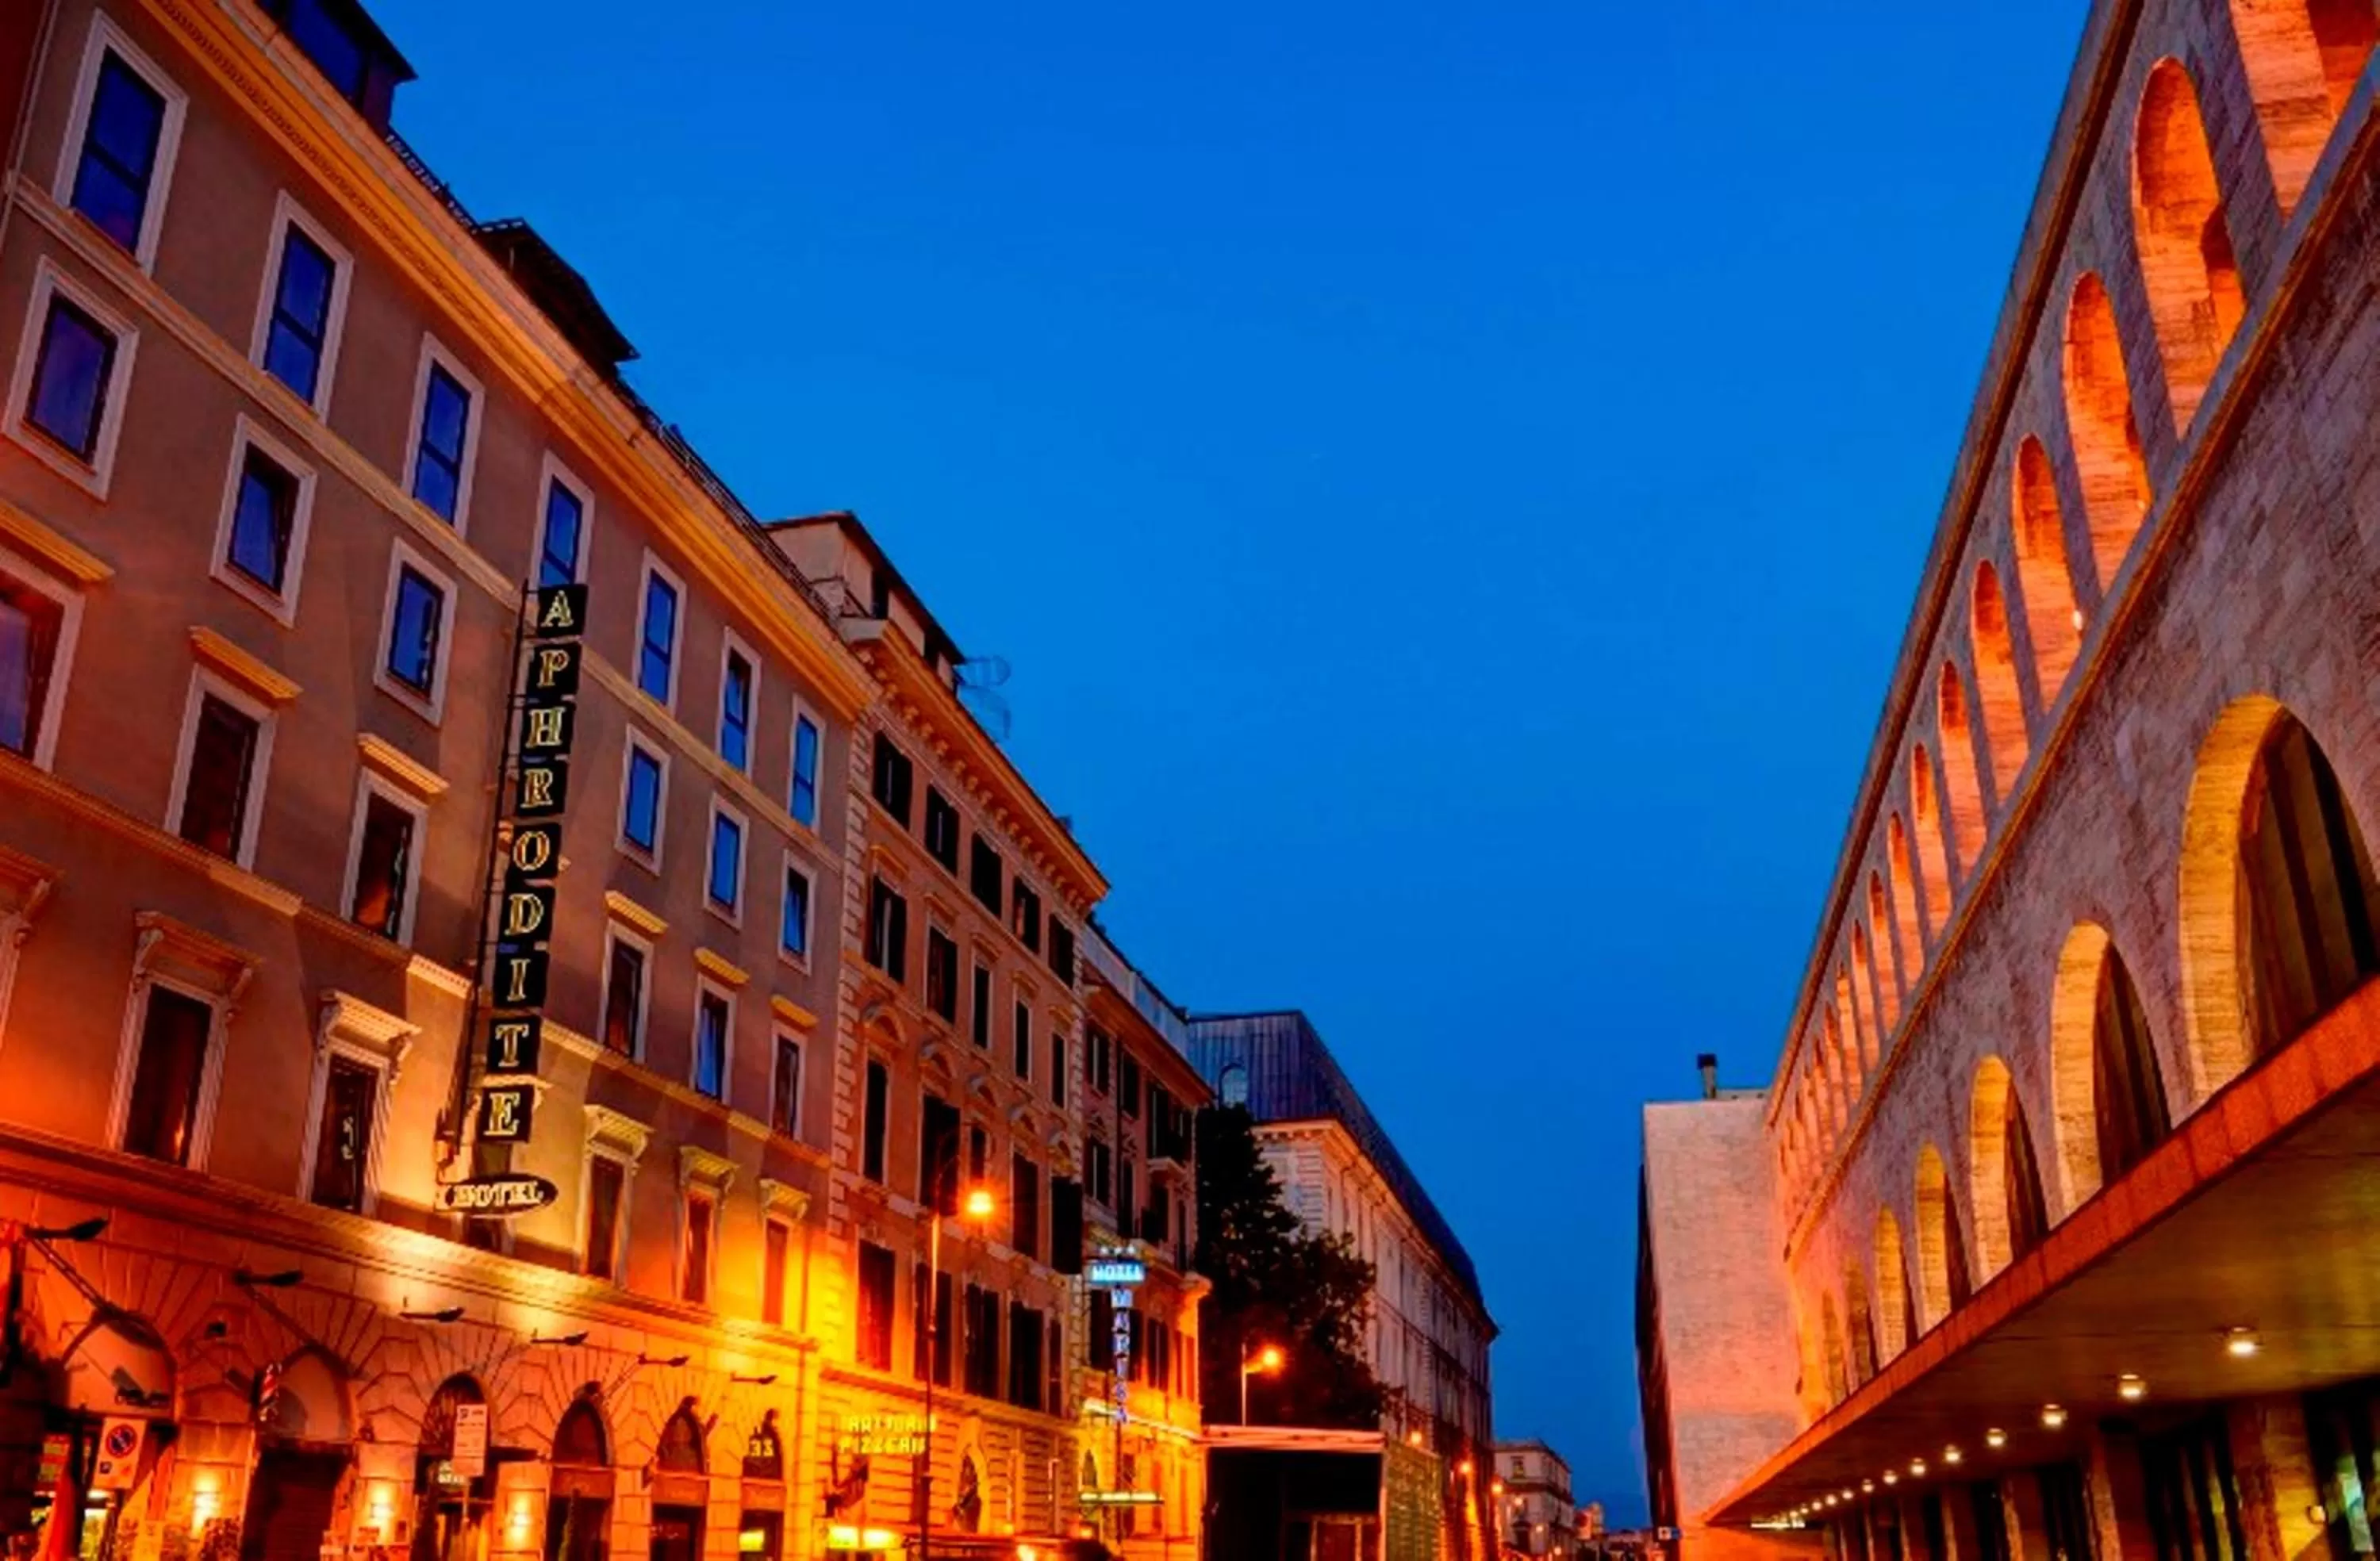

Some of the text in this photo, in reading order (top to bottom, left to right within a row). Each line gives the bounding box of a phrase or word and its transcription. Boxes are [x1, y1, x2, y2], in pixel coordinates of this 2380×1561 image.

[482, 589, 574, 1138] APHRODITE
[452, 1181, 543, 1209] HOTEL
[1092, 1264, 1143, 1282] HOTEL
